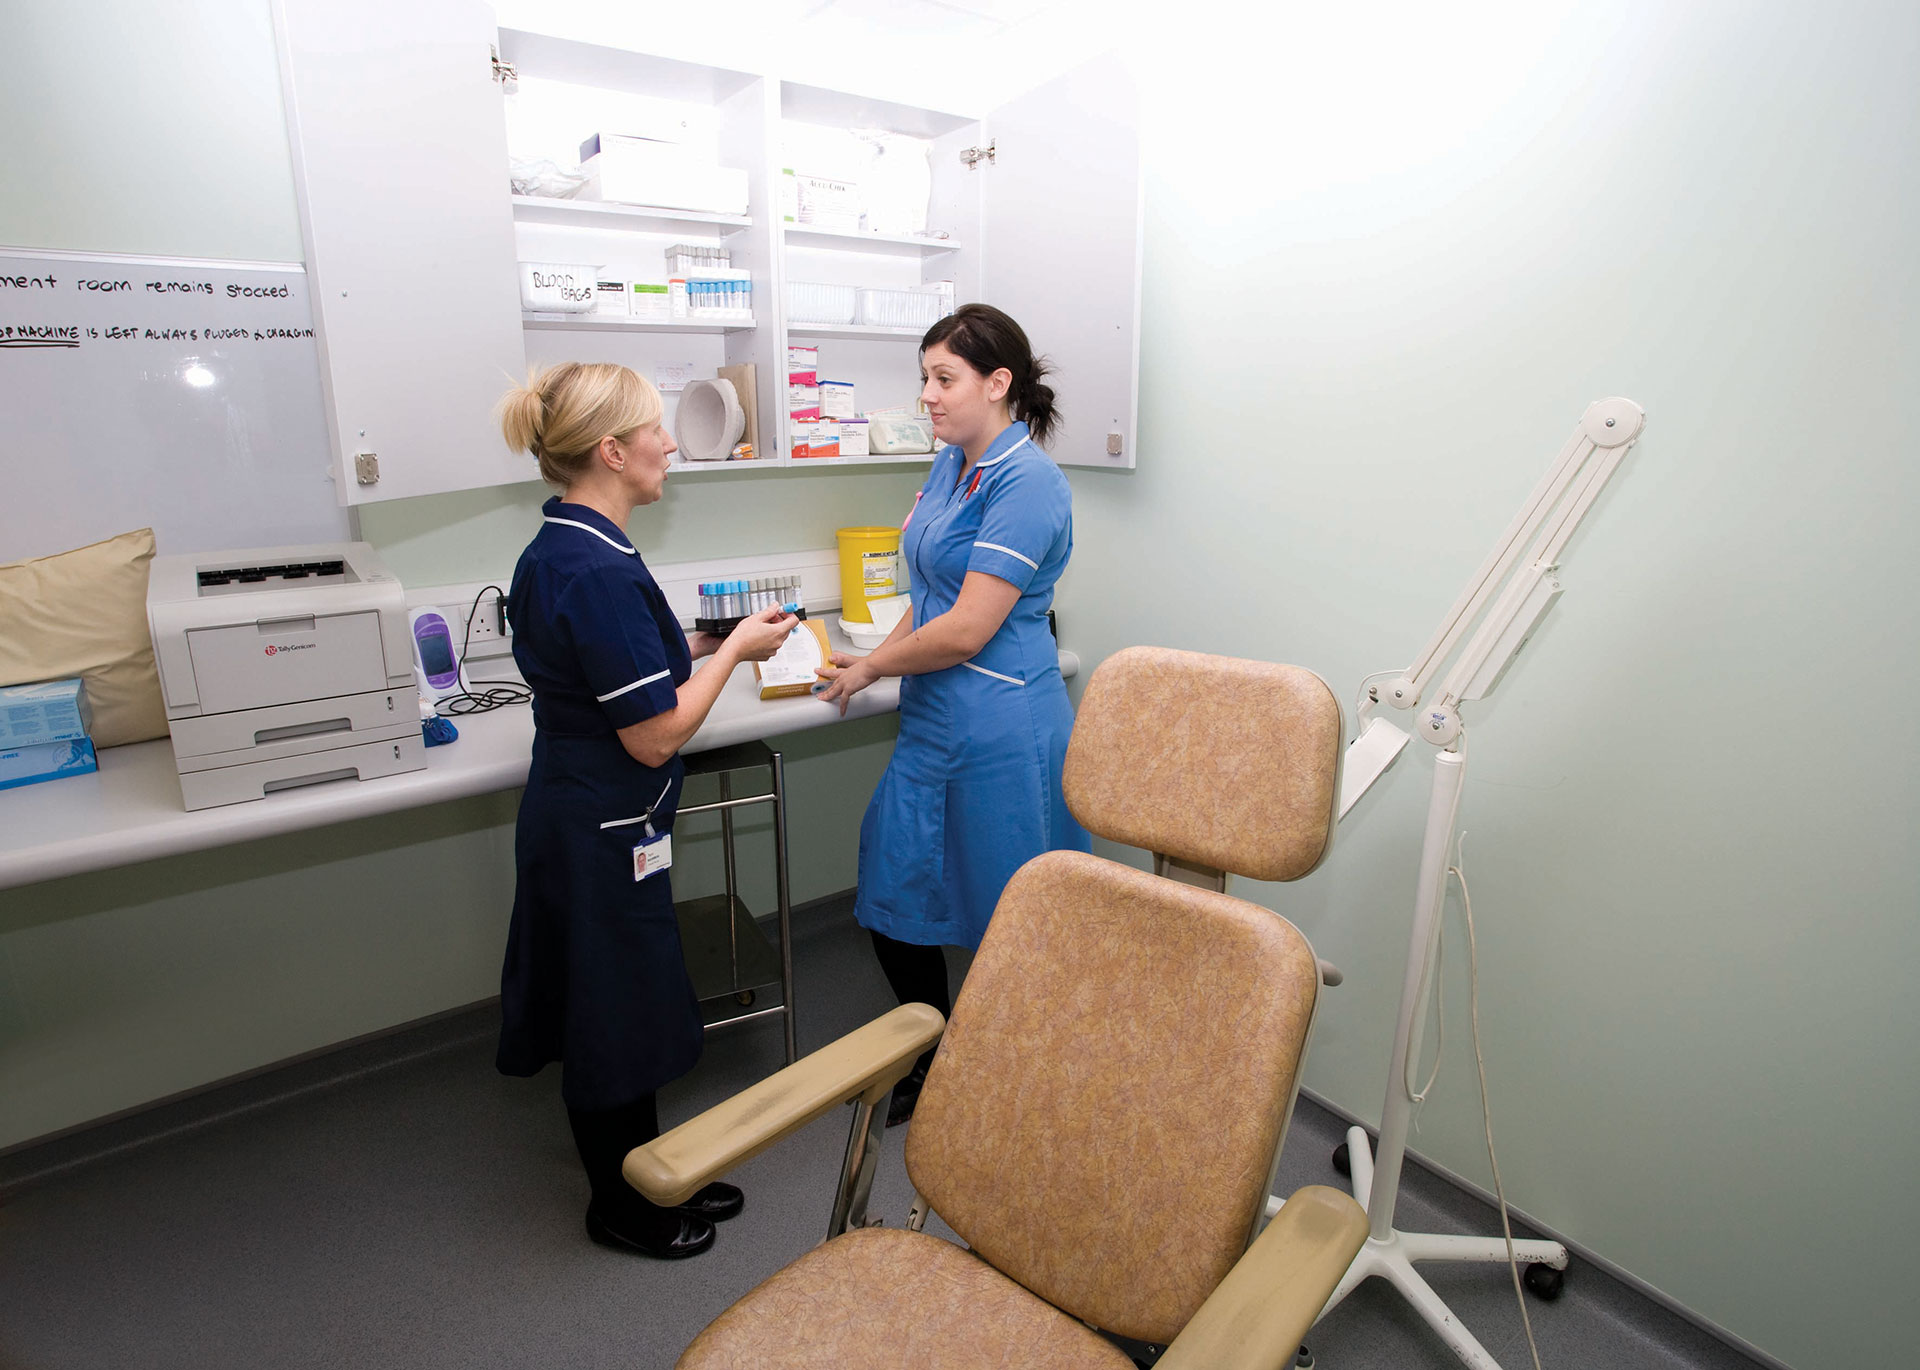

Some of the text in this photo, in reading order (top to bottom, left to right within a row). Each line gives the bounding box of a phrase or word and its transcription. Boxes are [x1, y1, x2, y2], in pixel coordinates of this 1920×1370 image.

[77, 278, 133, 292] room
[145, 280, 214, 294] remains
[533, 271, 575, 288] BLOOD
[561, 287, 592, 301] BAGS
[17, 326, 80, 339] MACHINE
[86, 328, 99, 339] IS
[104, 326, 139, 339] LEFT
[145, 328, 198, 341] ALWAYS
[204, 328, 250, 340] PLUGED
[266, 328, 317, 340] CHARGIN
